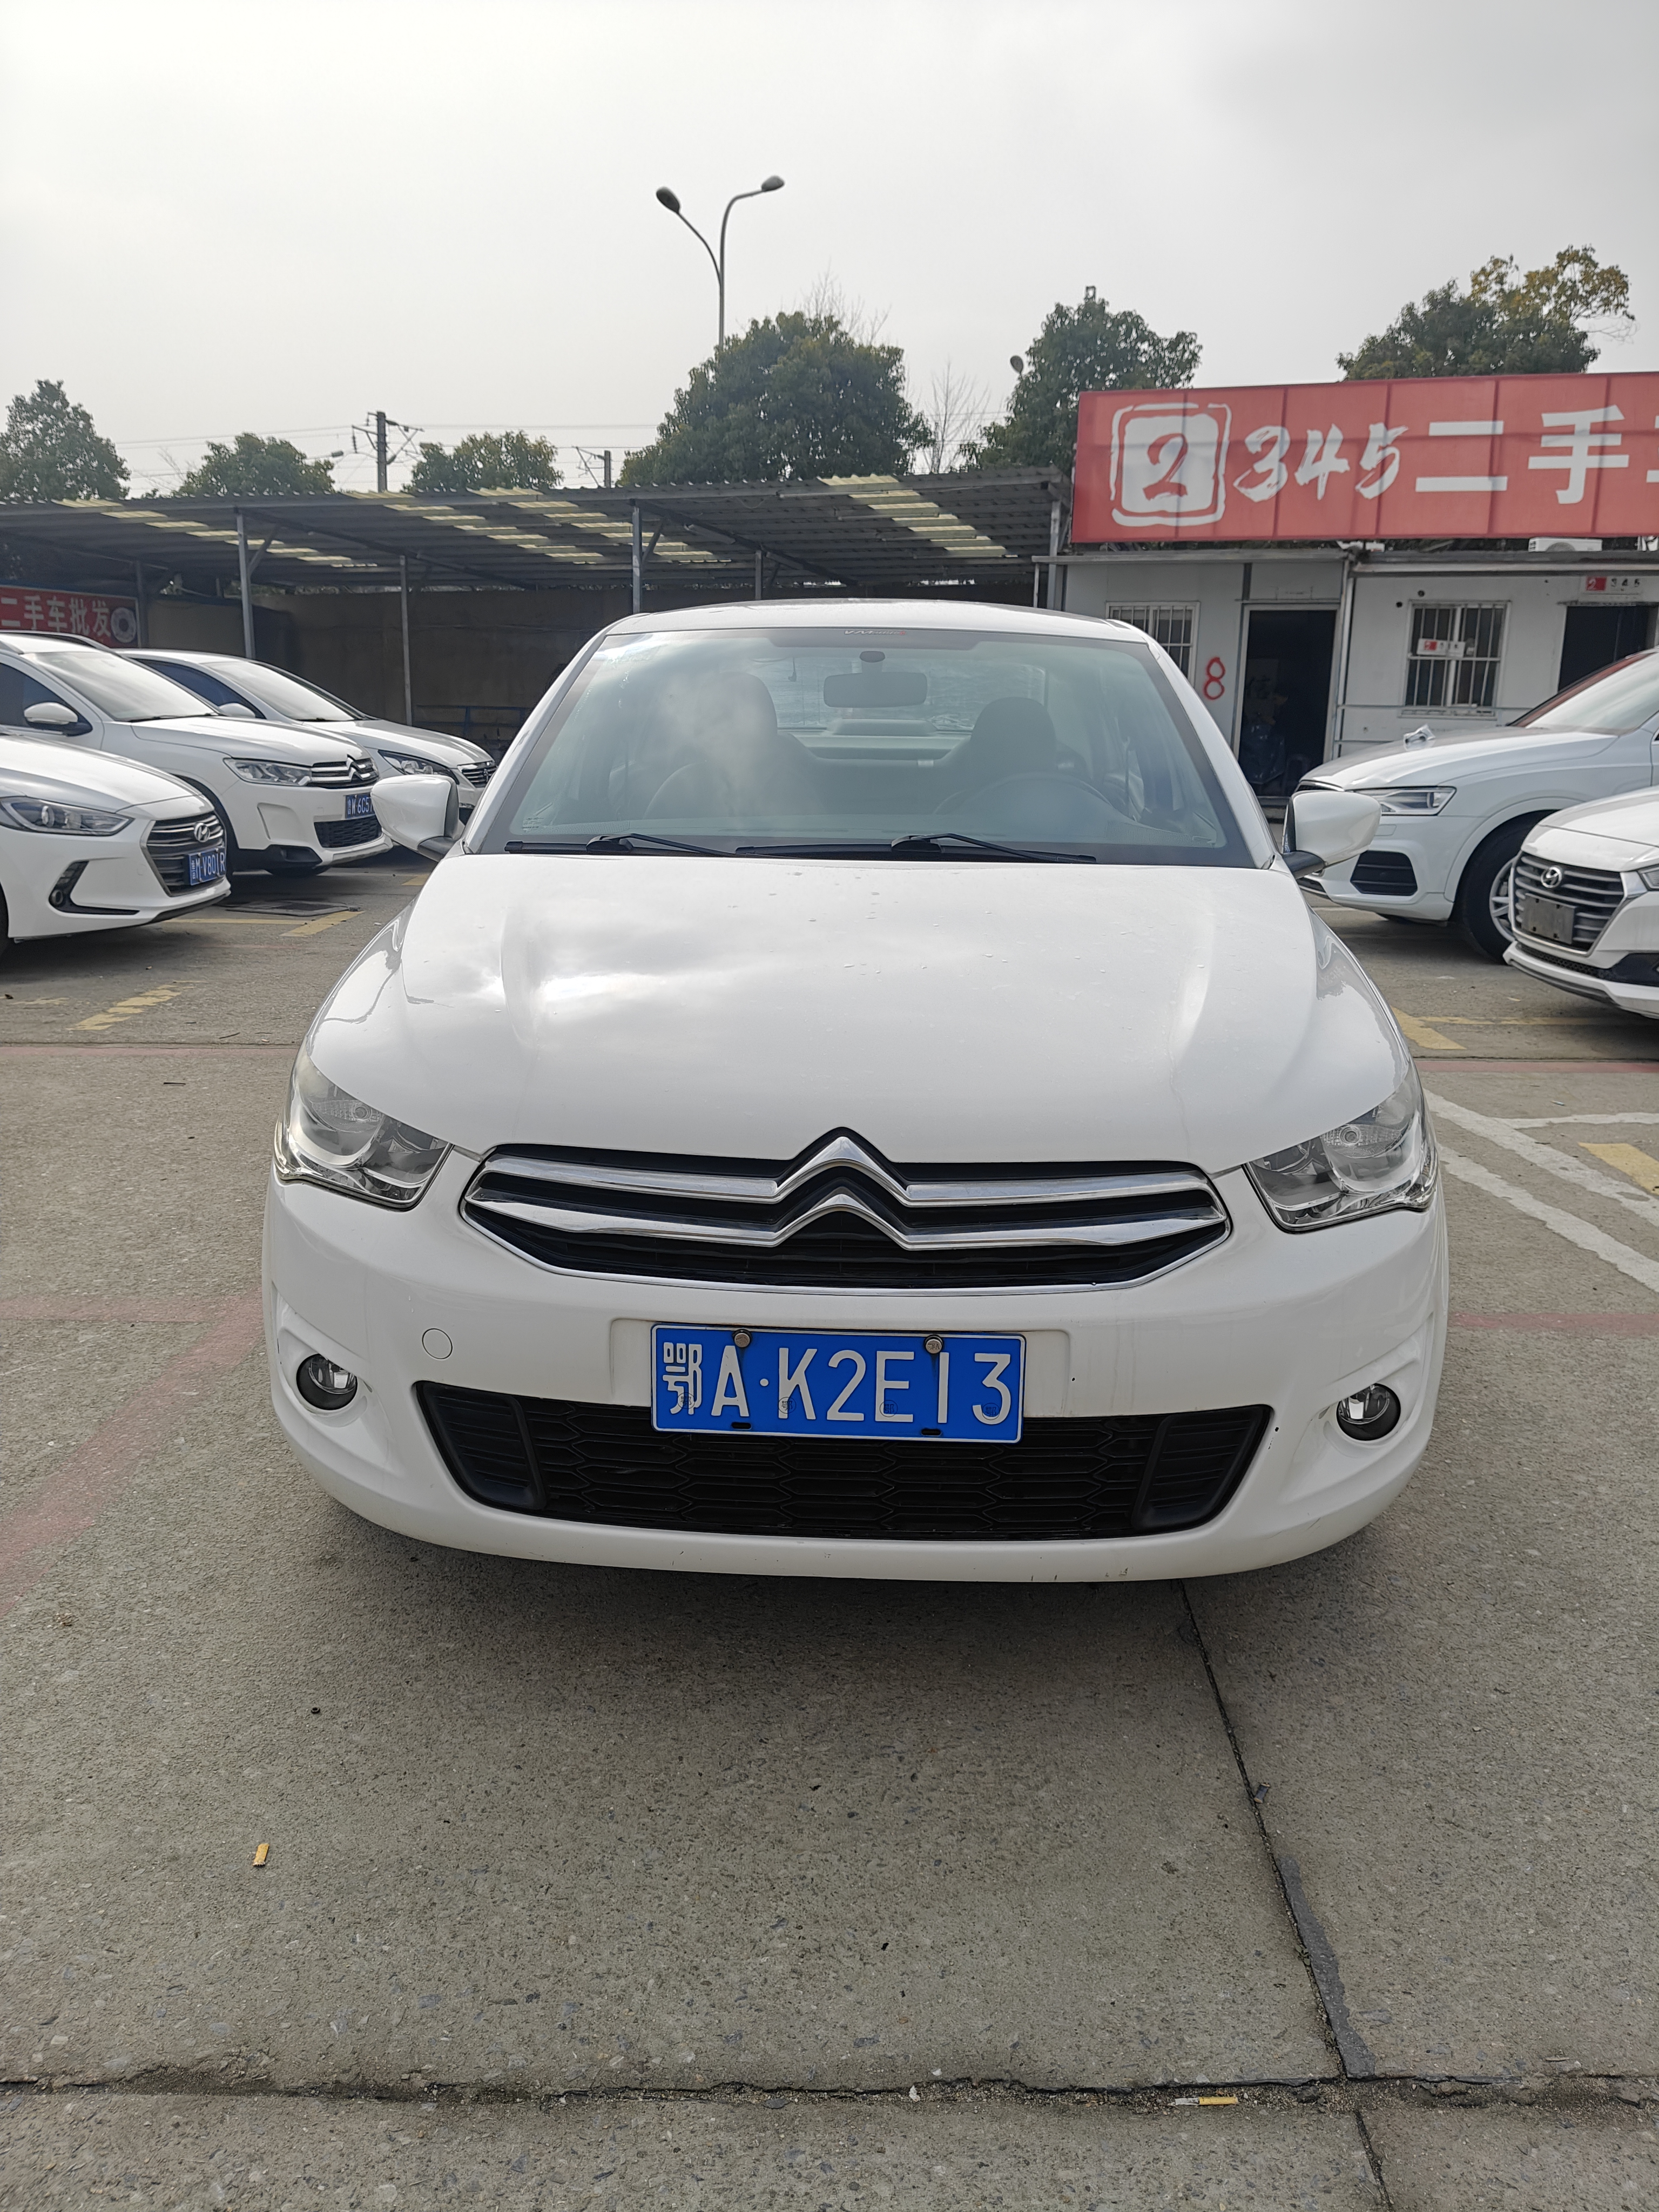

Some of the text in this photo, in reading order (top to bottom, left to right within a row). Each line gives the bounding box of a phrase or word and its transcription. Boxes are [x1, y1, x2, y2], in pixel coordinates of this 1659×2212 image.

[1142, 404, 1659, 504] 2345二手
[0, 595, 111, 637] 二手车批发
[1203, 656, 1226, 700] 8
[663, 1342, 1011, 1425] 鄂A·K2E13
